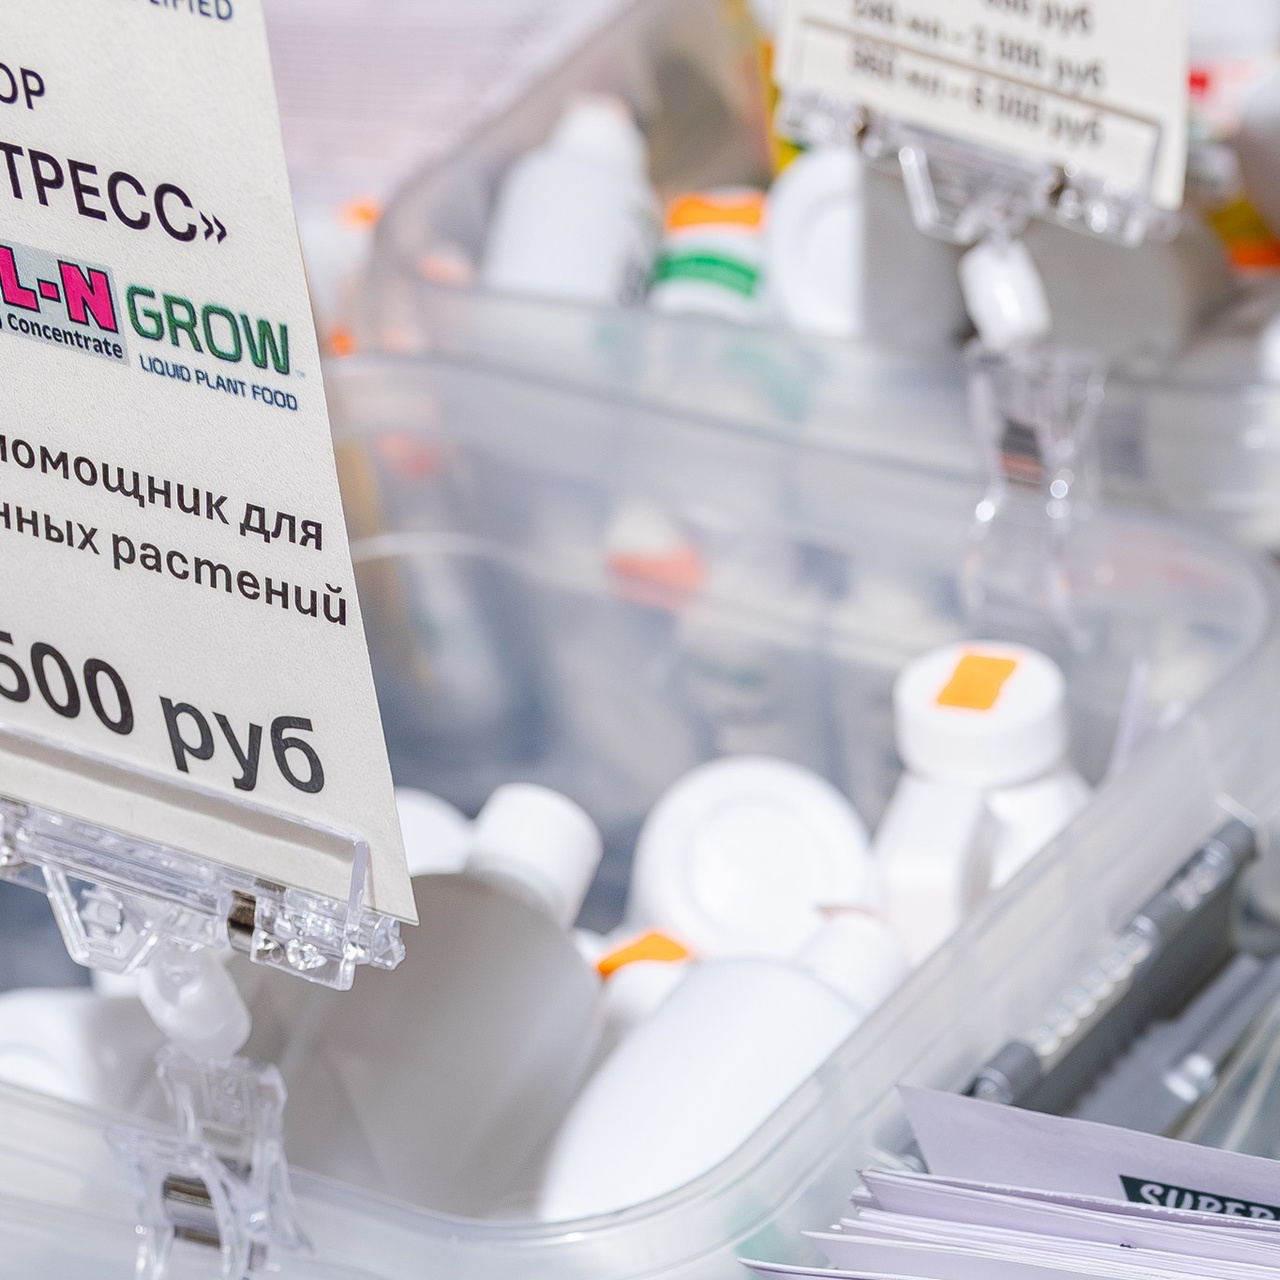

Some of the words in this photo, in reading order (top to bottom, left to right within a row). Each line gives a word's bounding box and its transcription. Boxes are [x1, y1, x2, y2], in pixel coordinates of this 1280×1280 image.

[7, 312, 123, 359] Concentrate
[126, 284, 291, 376] GROW
[139, 354, 192, 384] LIQUID
[195, 369, 249, 398] PLANT
[252, 384, 299, 412] FOOD
[239, 502, 324, 551] для
[111, 530, 347, 627] растений
[159, 695, 325, 794] руб
